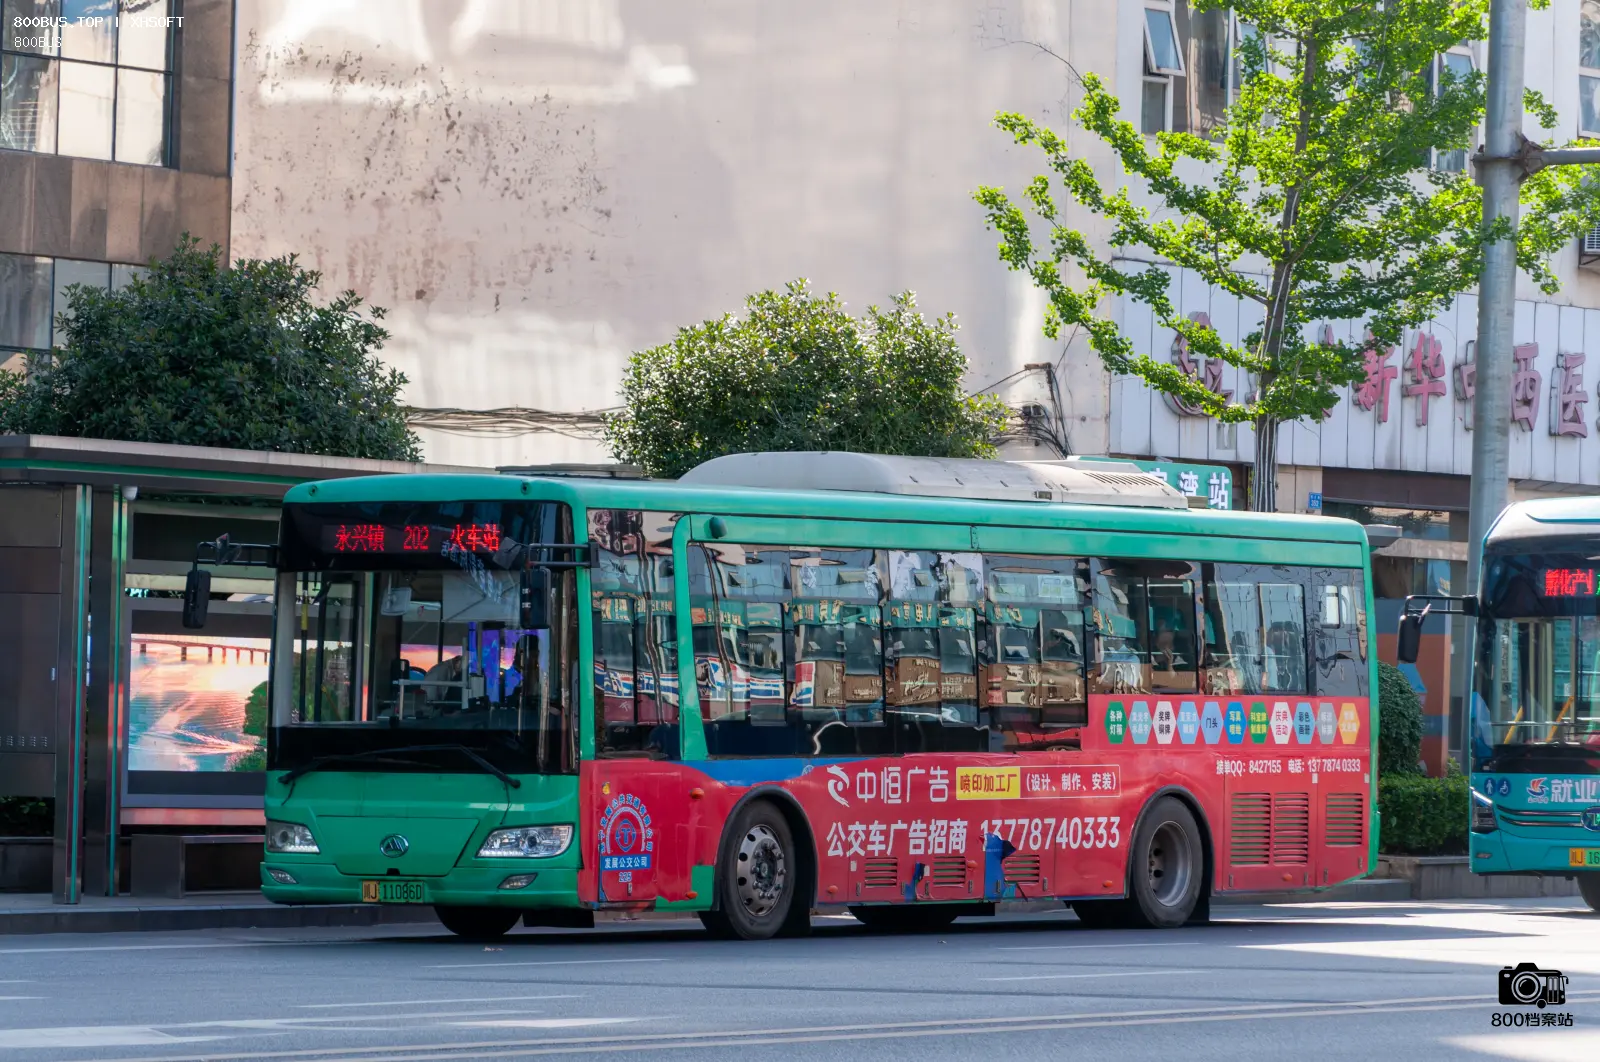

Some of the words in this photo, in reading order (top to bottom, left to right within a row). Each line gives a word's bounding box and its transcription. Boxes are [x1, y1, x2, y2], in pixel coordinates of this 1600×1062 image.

[334, 524, 385, 551] 永兴镇
[403, 525, 429, 550] 202
[450, 523, 500, 551] 火车站
[1206, 717, 1218, 729] 门头
[1249, 760, 1282, 774] 8427155
[856, 766, 950, 804] 中恒广告
[959, 773, 1017, 793] 喷印加工厂
[1551, 779, 1598, 803] 就业
[826, 819, 969, 857] 公交车广告招商
[604, 856, 648, 869] 发展公交公司
[618, 872, 632, 883] 225
